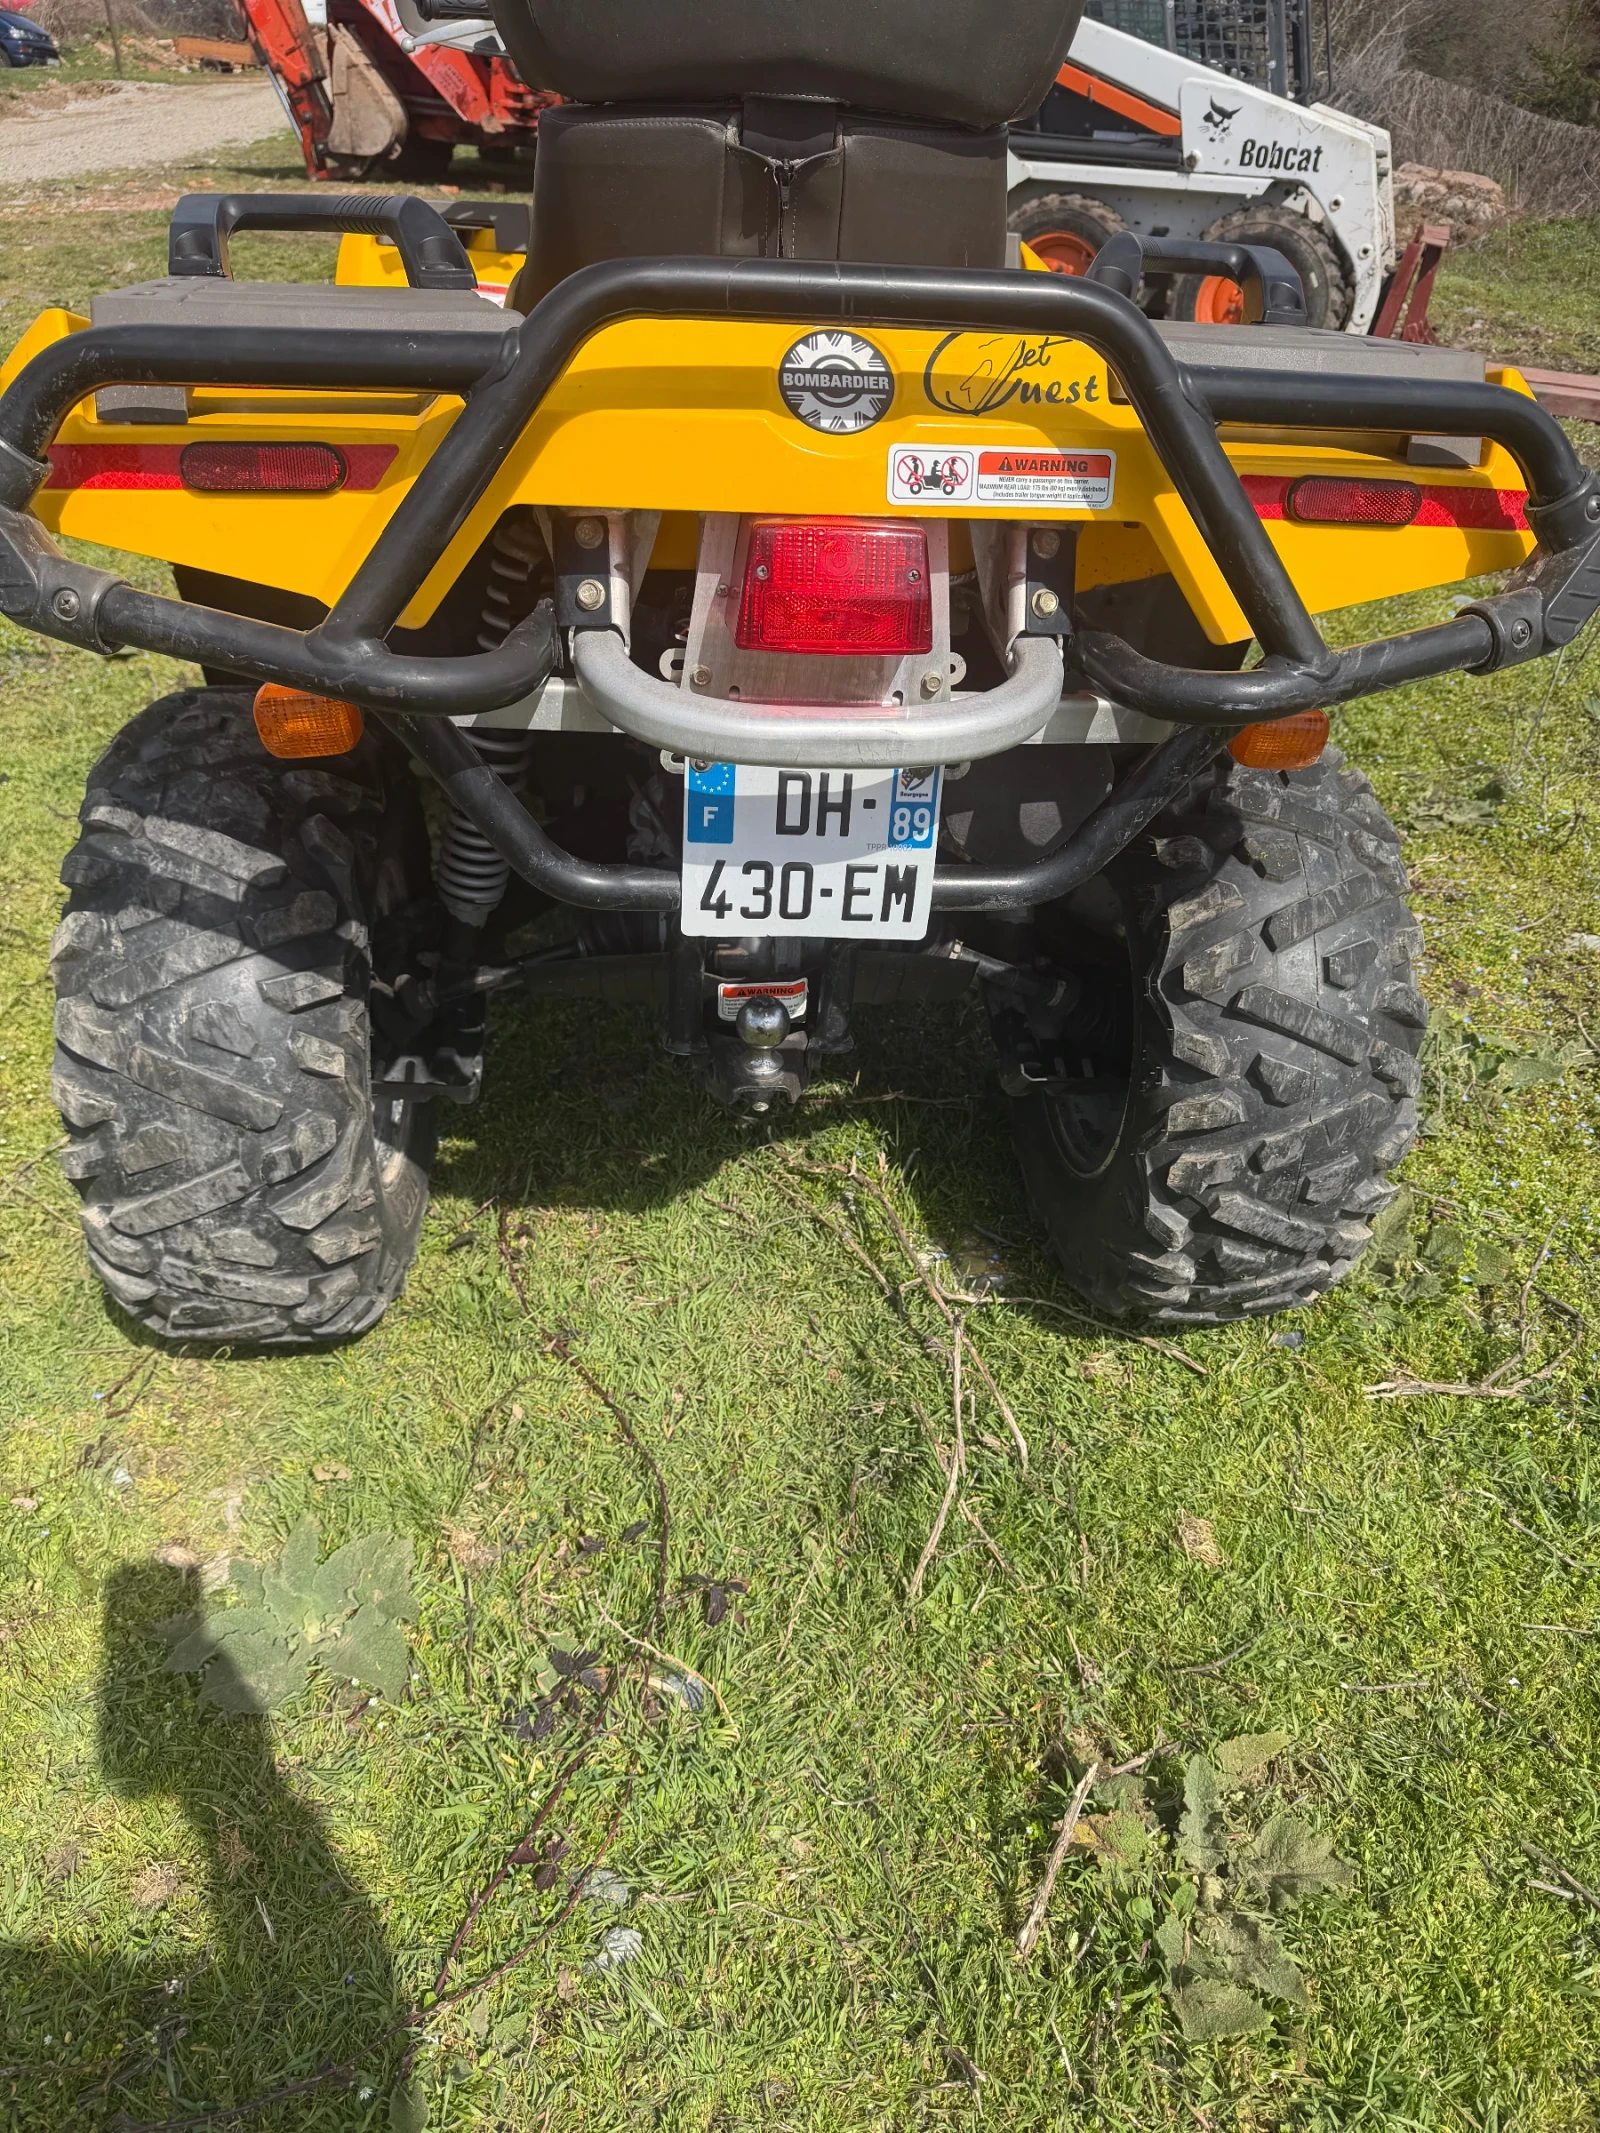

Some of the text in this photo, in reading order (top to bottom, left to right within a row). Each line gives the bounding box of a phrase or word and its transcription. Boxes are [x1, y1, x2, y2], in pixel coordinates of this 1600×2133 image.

[1239, 138, 1323, 172] Bobcat
[783, 373, 889, 390] BOMBARDIER
[1015, 460, 1089, 472] WARNING
[703, 806, 719, 828] F
[893, 807, 931, 842] 89
[700, 859, 919, 923] 430-EM
[747, 987, 795, 995] WARNING
